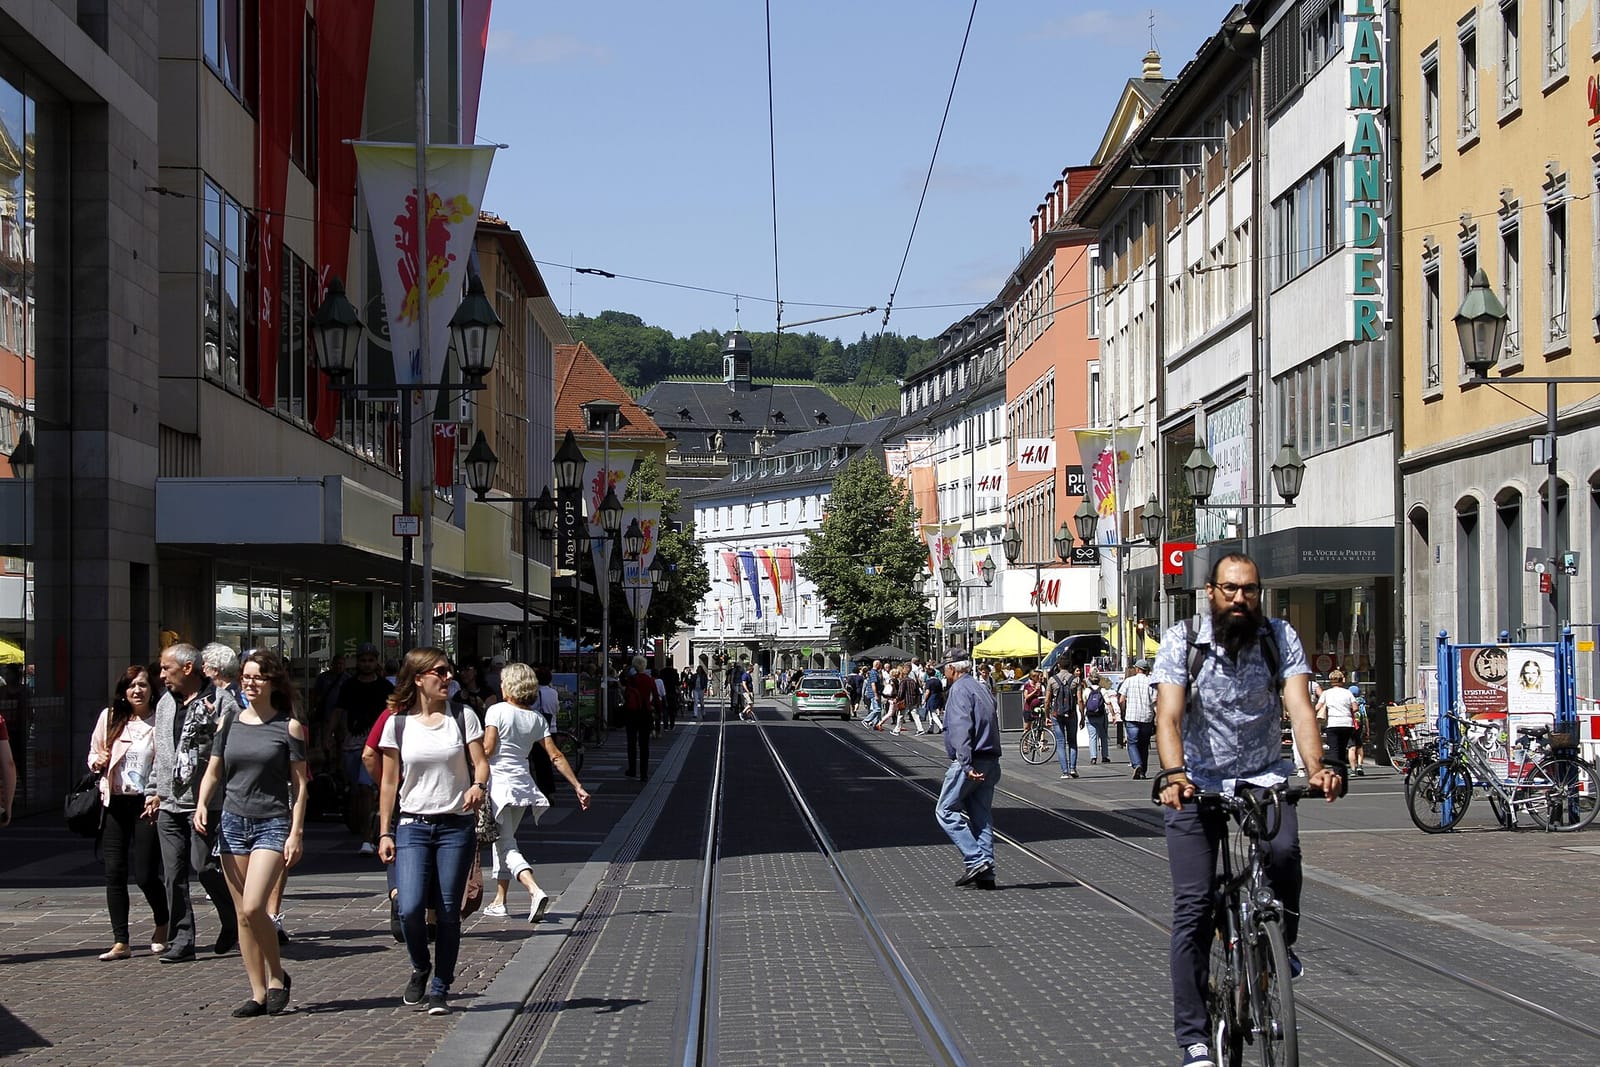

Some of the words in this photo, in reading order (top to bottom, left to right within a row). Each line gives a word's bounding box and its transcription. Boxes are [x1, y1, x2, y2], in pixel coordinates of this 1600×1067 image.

[1021, 445, 1049, 464] H&M
[977, 475, 1001, 492] H&M
[565, 529, 575, 565] Marc
[1030, 579, 1061, 608] H&M
